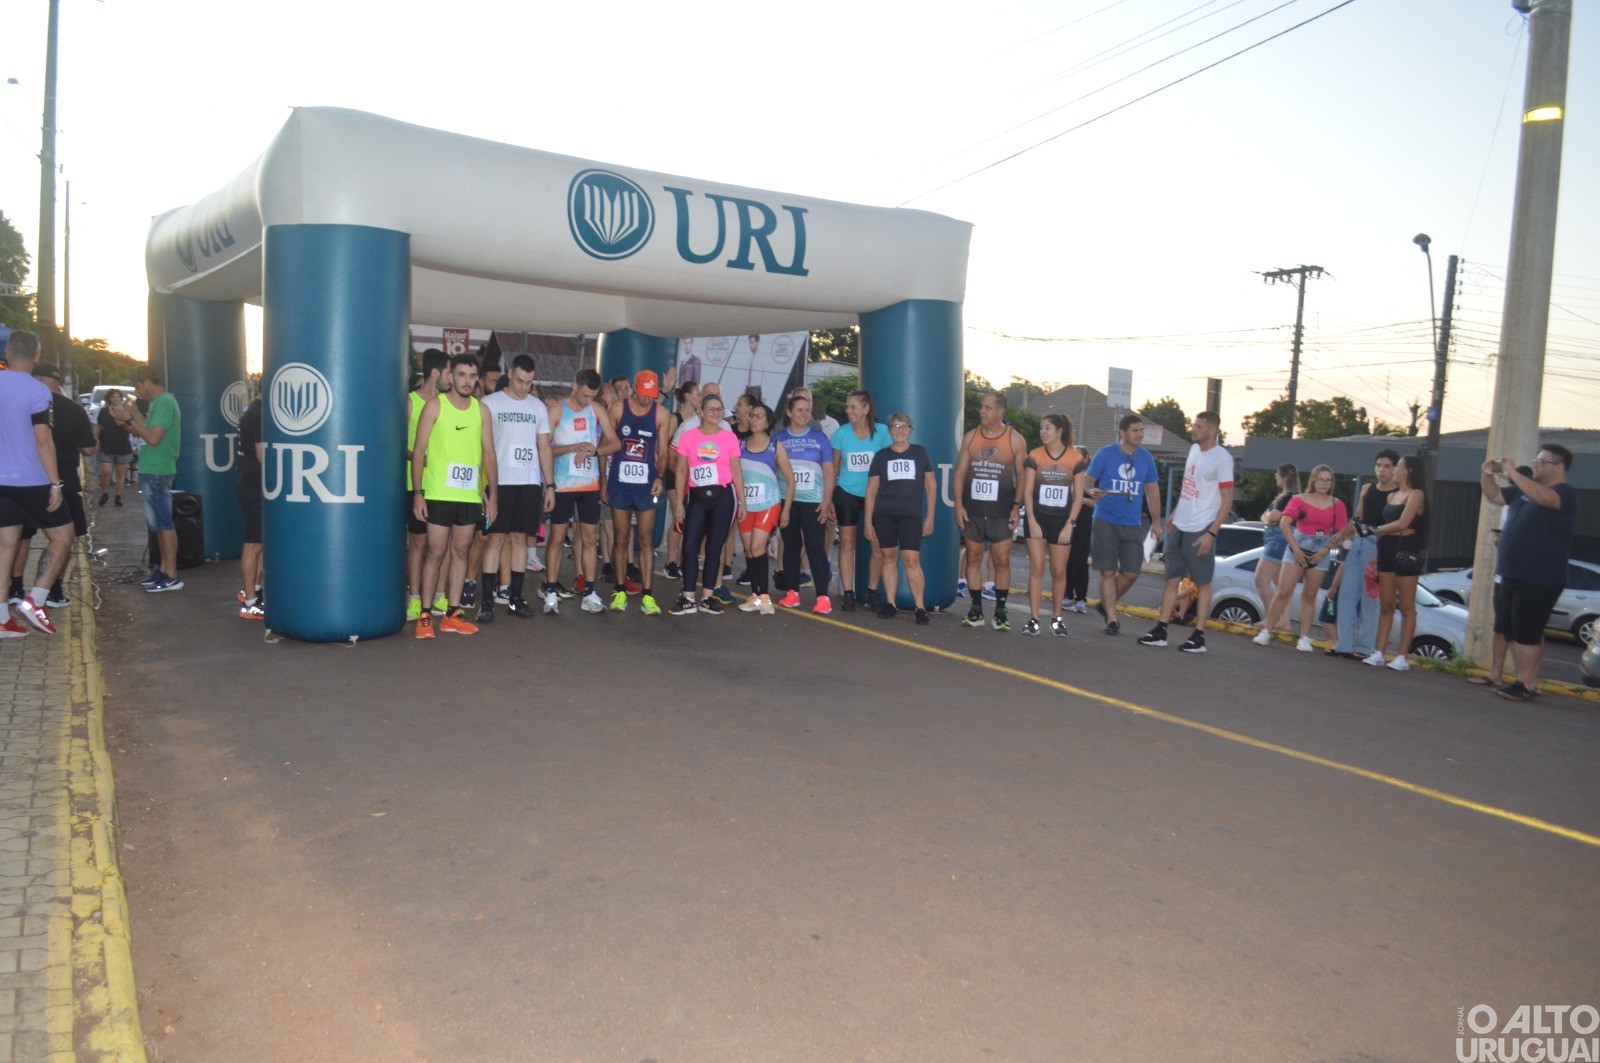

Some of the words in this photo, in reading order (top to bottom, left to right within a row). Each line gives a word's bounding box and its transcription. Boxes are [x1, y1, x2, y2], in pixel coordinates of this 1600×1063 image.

[663, 186, 809, 276] URI
[497, 412, 537, 425] FISIOTERAPIA
[514, 447, 533, 462] 025
[850, 453, 869, 466] 030
[624, 464, 644, 477] 003
[892, 460, 910, 473] 018
[262, 443, 365, 504] URI
[452, 466, 473, 481] 030
[694, 466, 713, 481] 023
[975, 481, 992, 494] 001
[1045, 487, 1063, 500] 001
